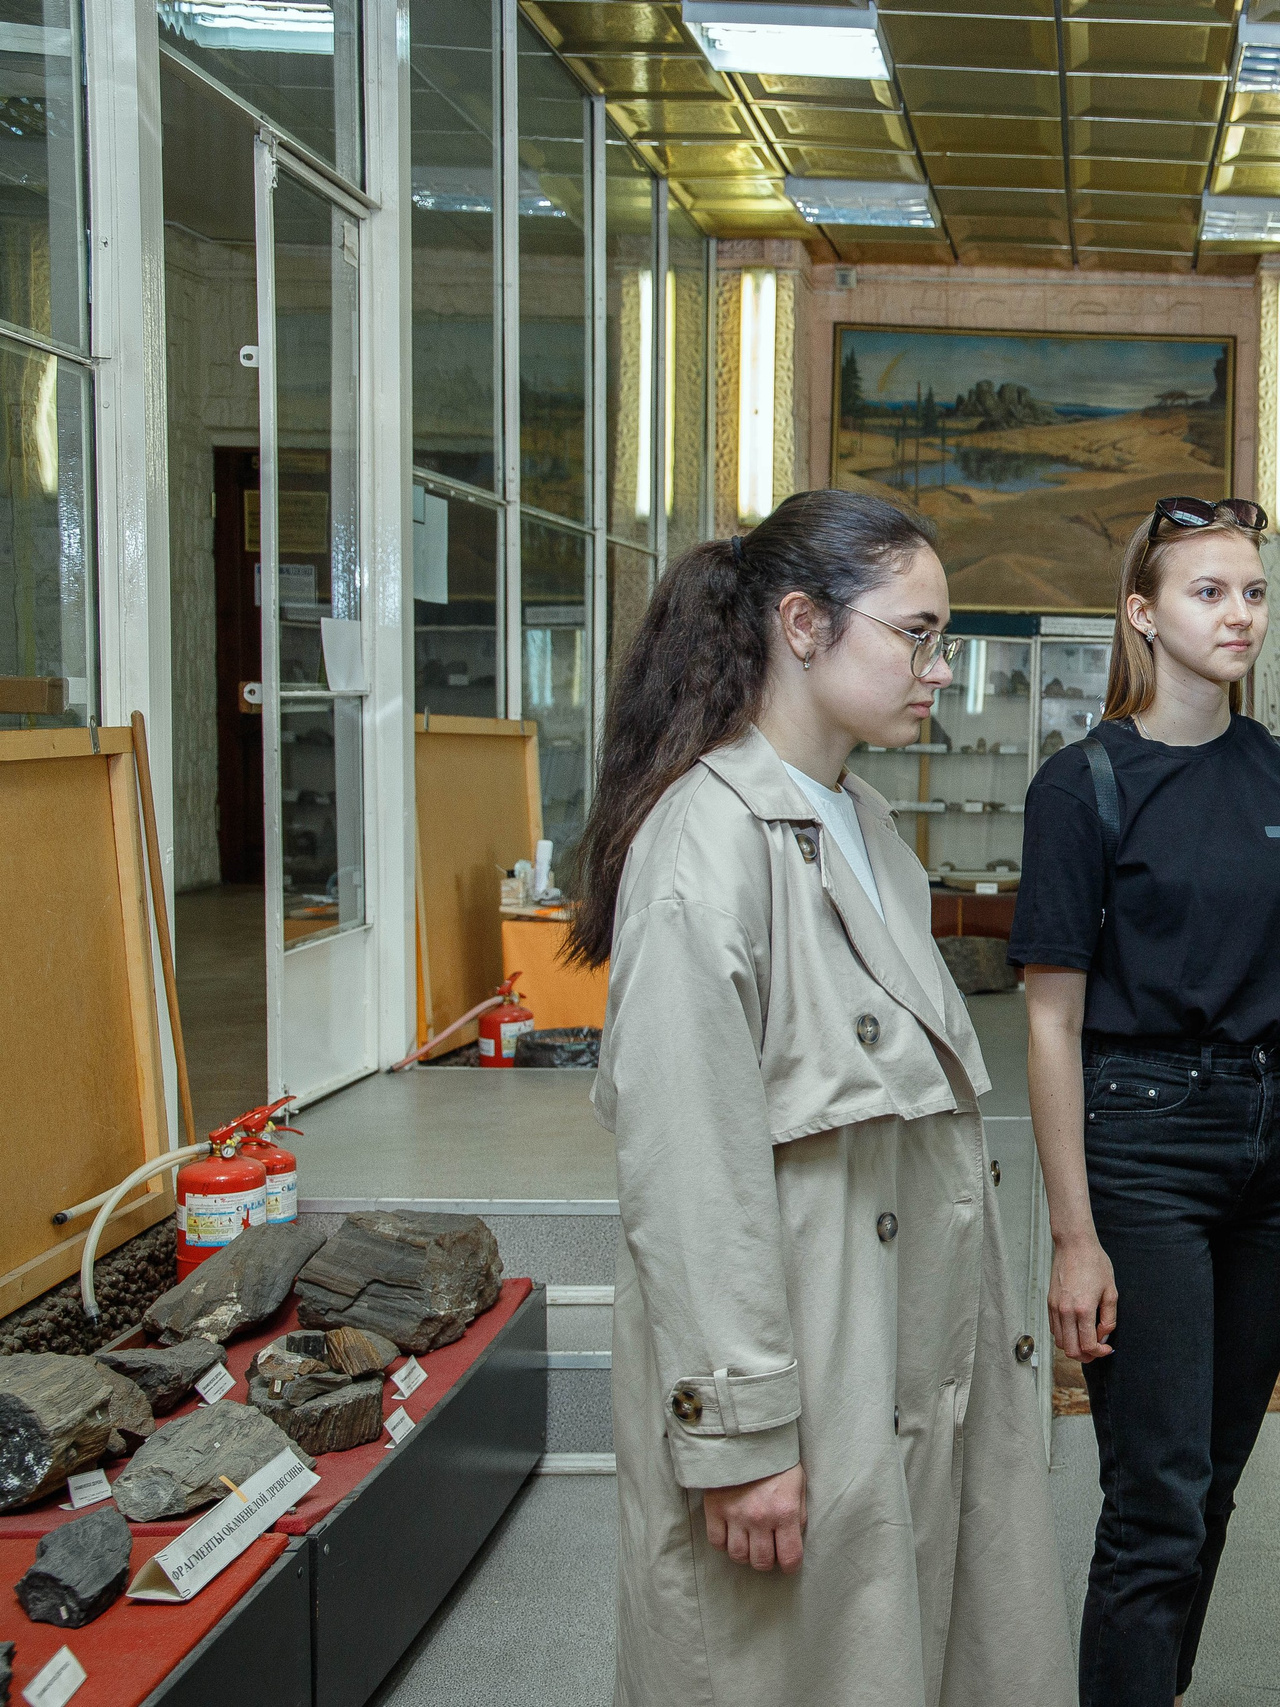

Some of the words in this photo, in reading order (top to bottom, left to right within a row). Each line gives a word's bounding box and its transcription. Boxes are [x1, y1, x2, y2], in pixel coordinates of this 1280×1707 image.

[170, 1531, 226, 1581] ФРАГМЕНТЫ
[222, 1491, 270, 1537] ОКАМЕНЕЛОЙ
[266, 1462, 306, 1500] ДРЕВЕСИНЫ
